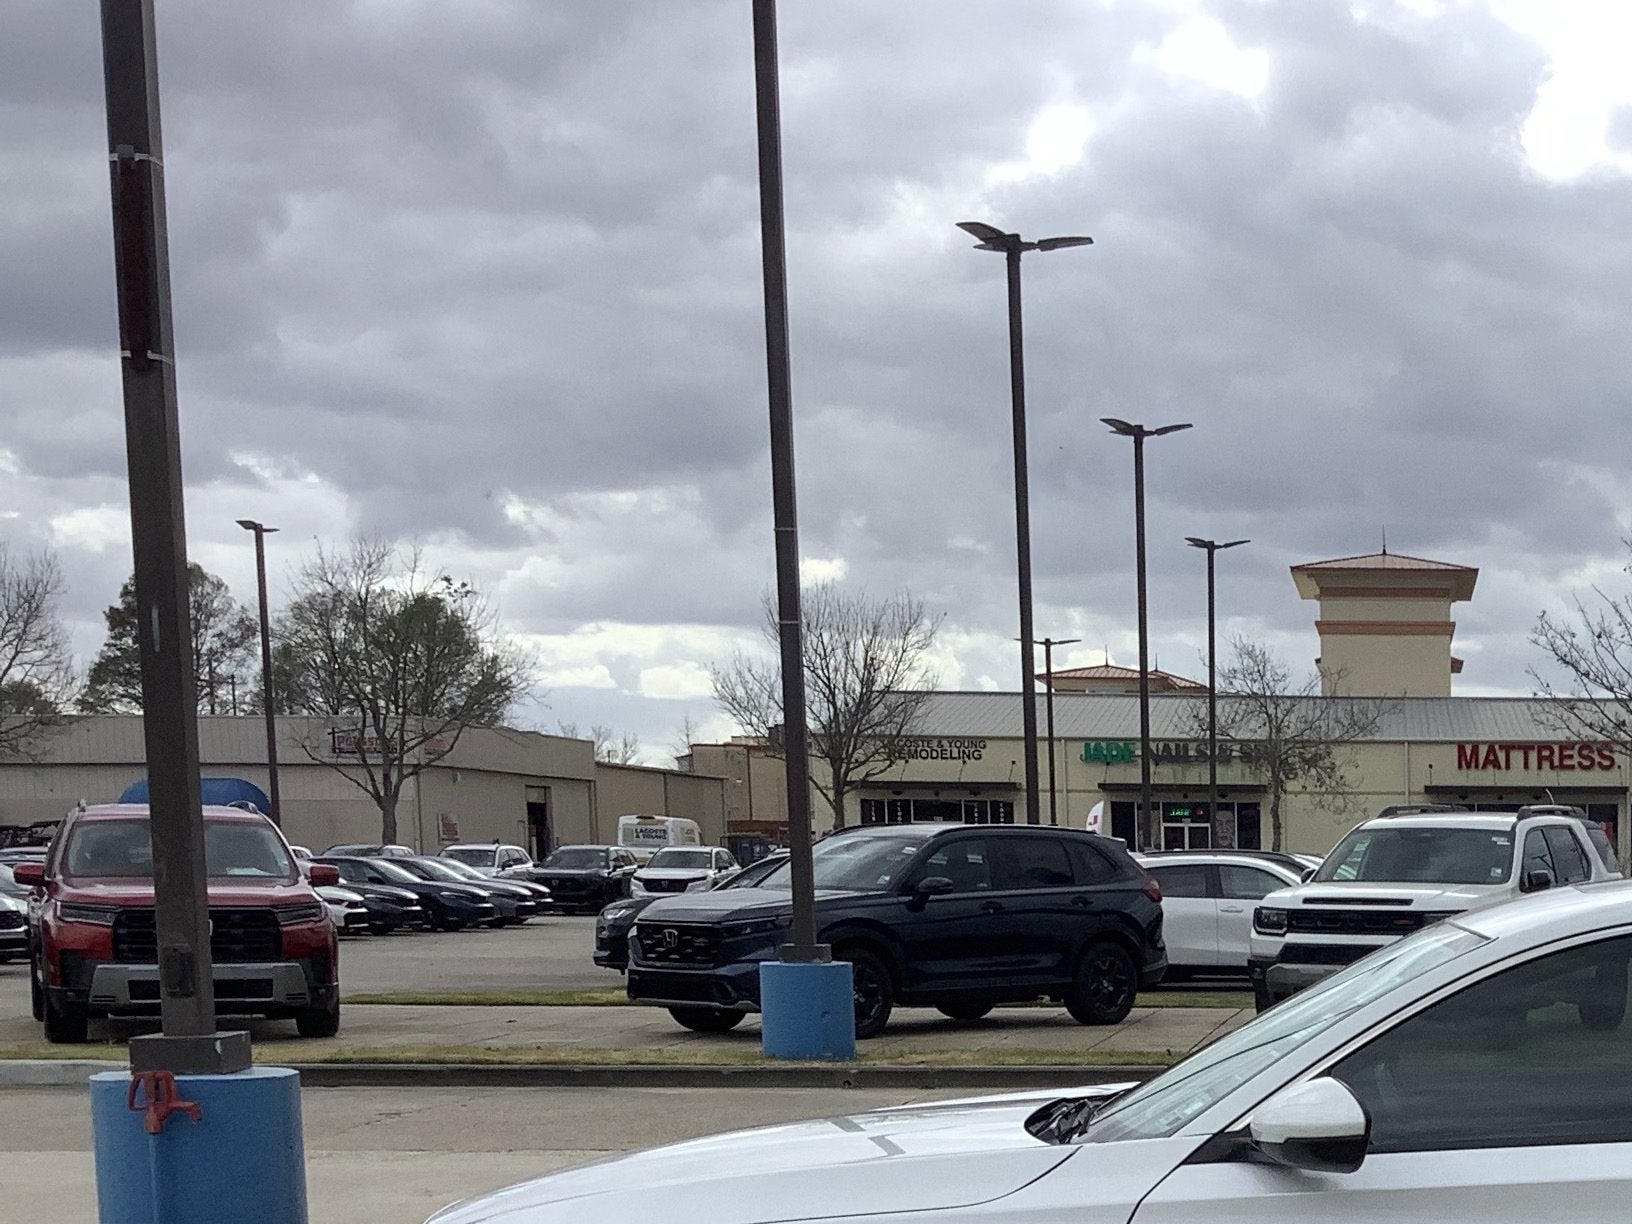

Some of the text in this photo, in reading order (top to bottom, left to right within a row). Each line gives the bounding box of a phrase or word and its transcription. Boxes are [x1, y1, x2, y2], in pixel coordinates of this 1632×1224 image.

[936, 740, 944, 748] &
[947, 739, 987, 750] YOUNG
[894, 748, 982, 760] EMODELING
[1457, 744, 1615, 771] MATTRESS
